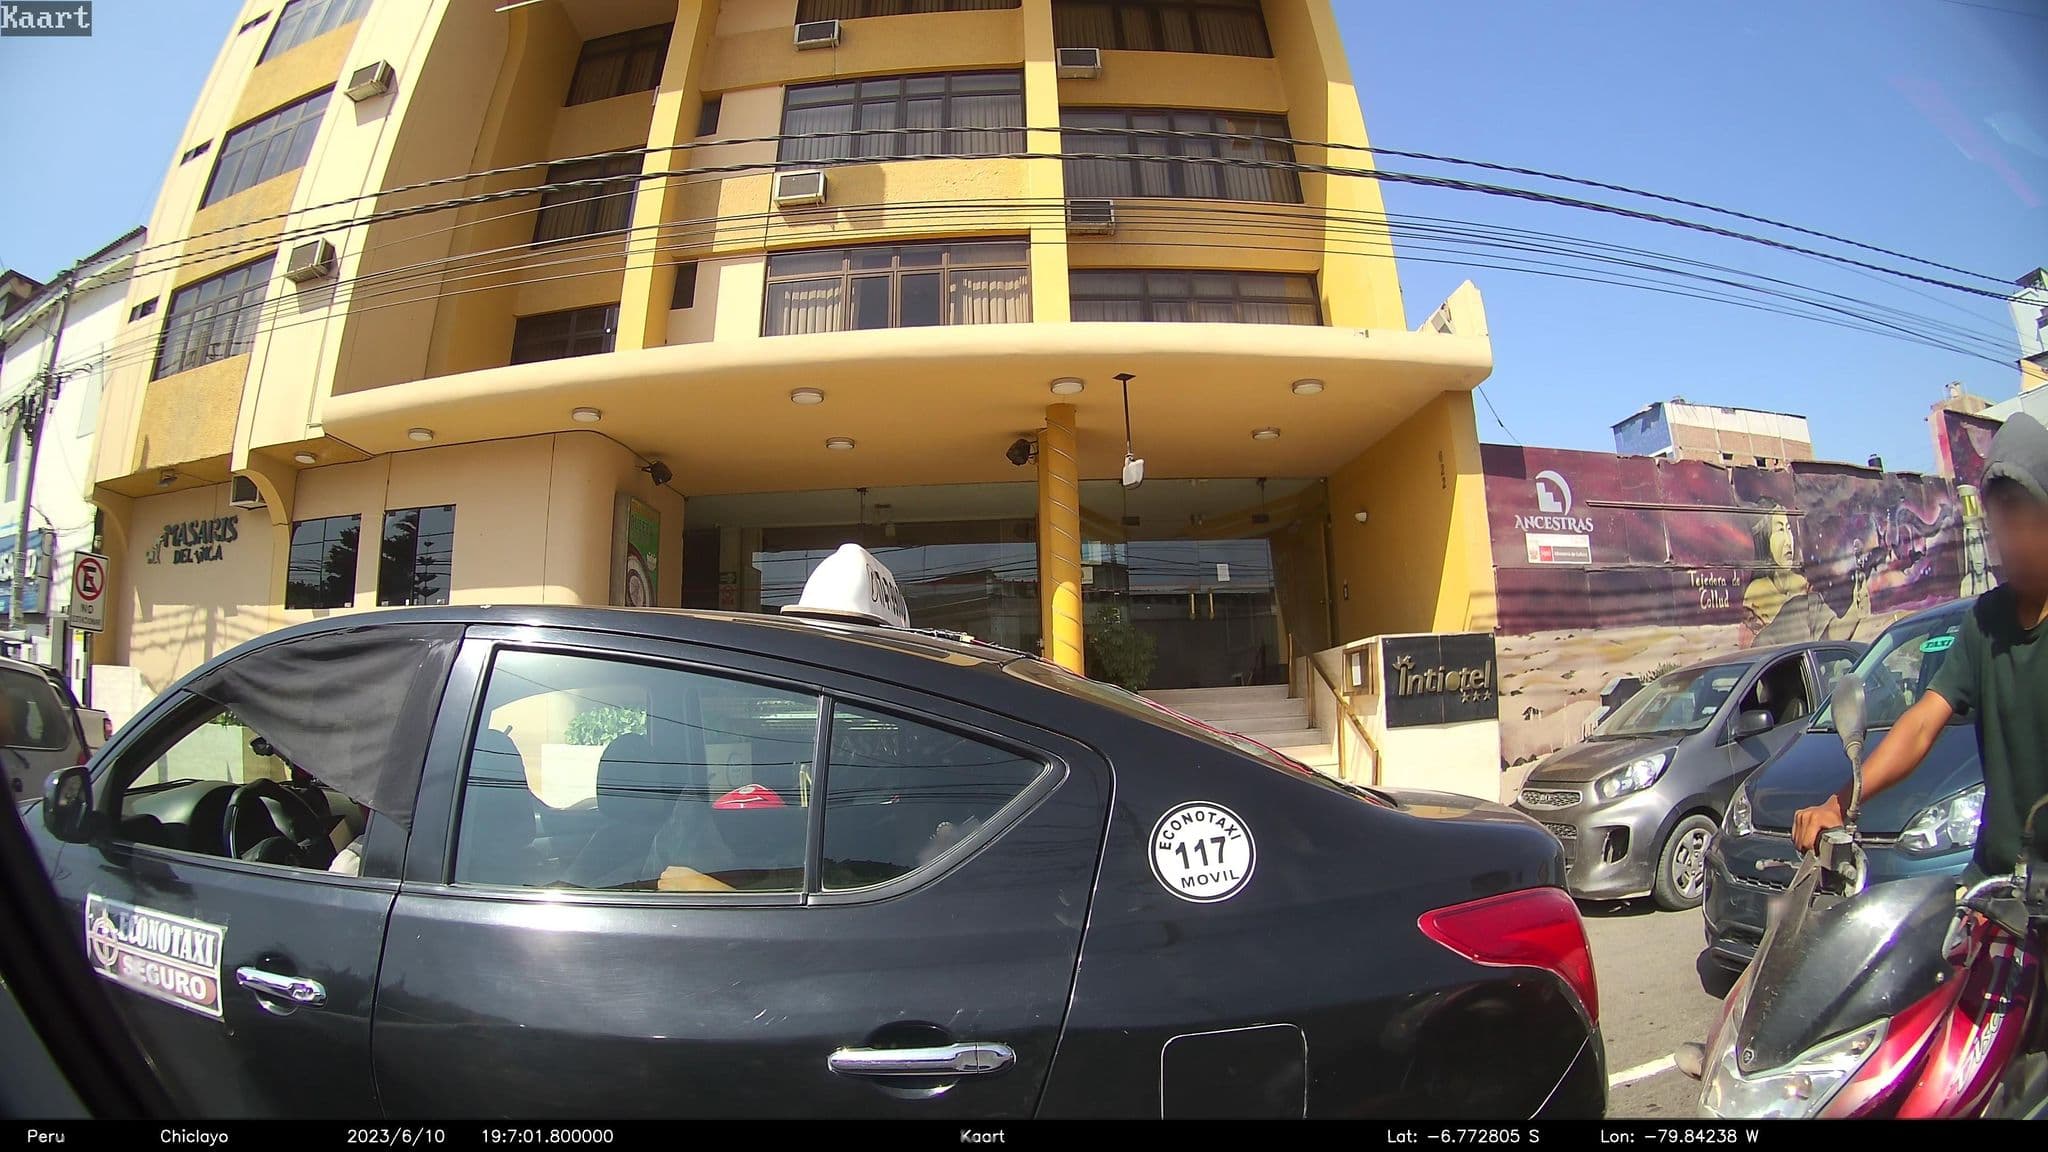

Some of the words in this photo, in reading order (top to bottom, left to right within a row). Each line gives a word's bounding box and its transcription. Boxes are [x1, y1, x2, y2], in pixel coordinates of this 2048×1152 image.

[1514, 514, 1594, 533] ANCESTRAS
[173, 548, 193, 564] DEL
[1687, 570, 1727, 592] Tejedora
[1700, 588, 1730, 610] Collud
[1924, 638, 1952, 649] TAXI
[1159, 810, 1242, 851] ECONOTAXI
[1175, 836, 1226, 870] 117
[1181, 869, 1240, 889] MOVIL
[118, 911, 216, 968] ECONOTAXI
[122, 955, 208, 1001] SEGURO
